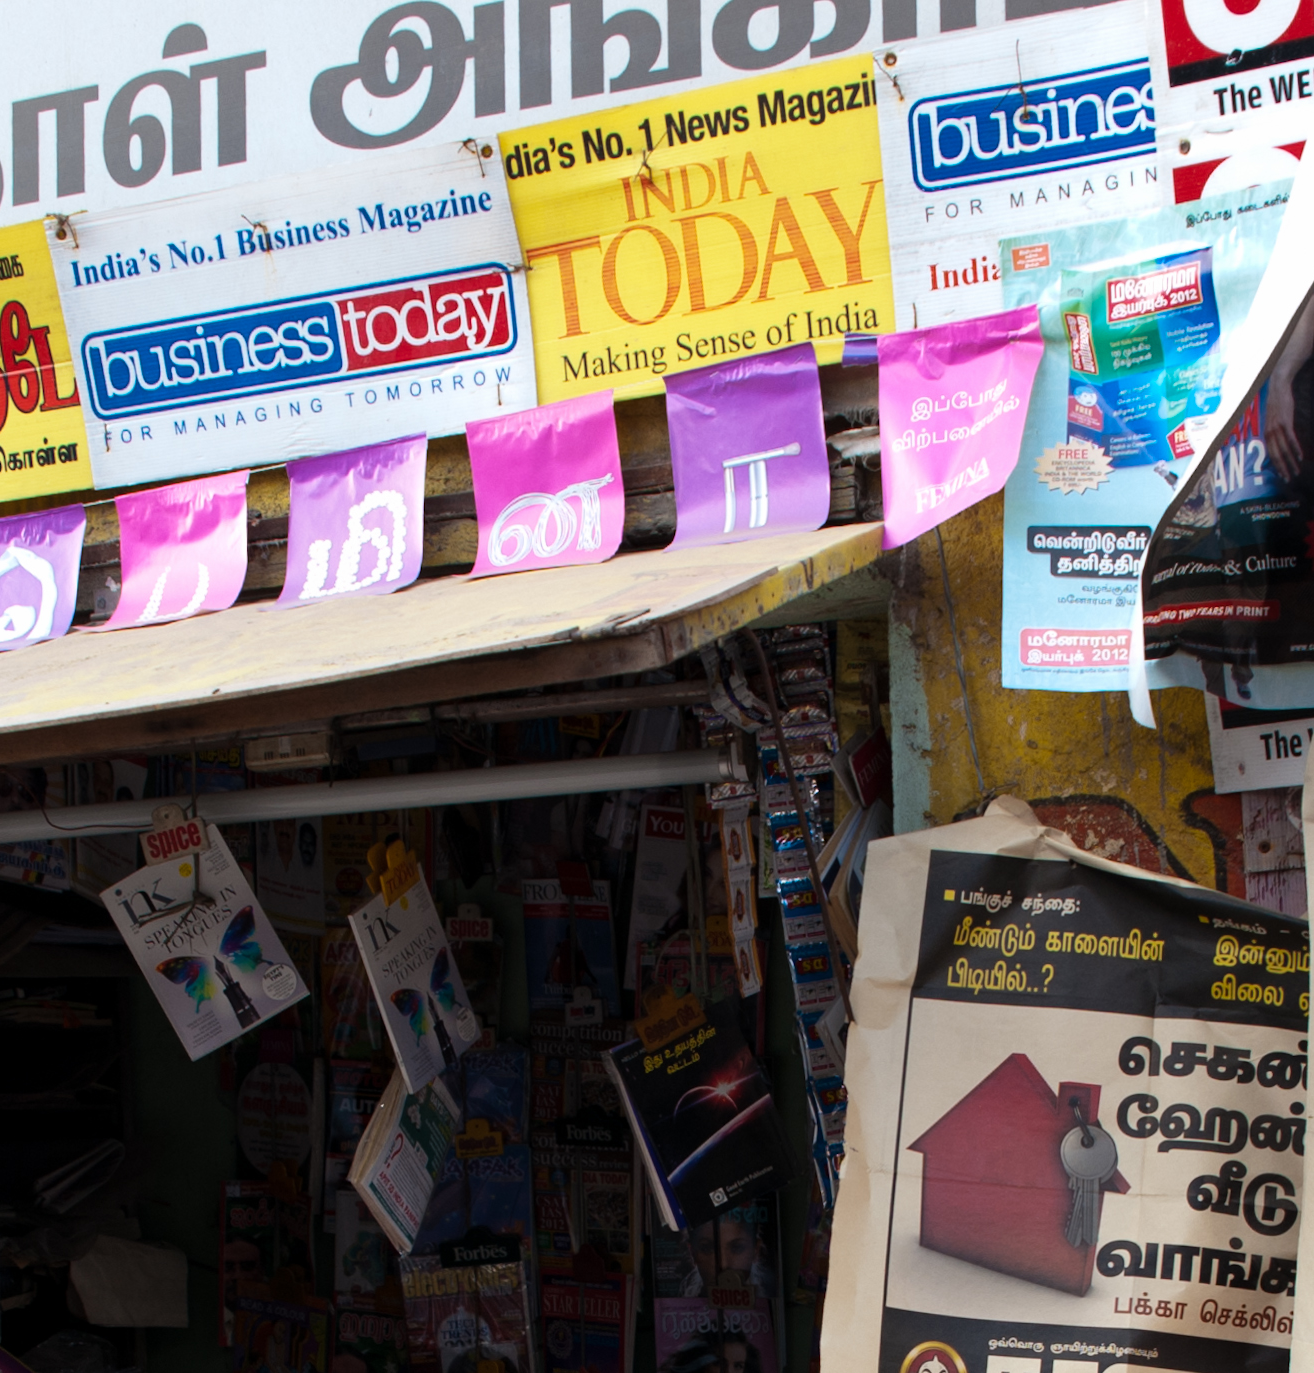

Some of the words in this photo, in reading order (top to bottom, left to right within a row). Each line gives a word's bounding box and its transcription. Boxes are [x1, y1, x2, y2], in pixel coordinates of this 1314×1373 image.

[1213, 83, 1263, 117] The
[665, 103, 750, 147] News
[619, 150, 774, 224] INDIA
[237, 211, 350, 256] Business
[357, 188, 494, 240] Magazine
[924, 197, 984, 223] FOR
[525, 179, 885, 340] TODAY
[1170, 287, 1200, 306] 2012
[92, 308, 336, 399] business
[343, 277, 506, 354] today
[562, 340, 669, 385] Making
[675, 329, 758, 364] Sense
[803, 302, 881, 338] India
[174, 397, 325, 436] MANAGING
[345, 366, 514, 407] TOMORROW
[910, 378, 1009, 424] இப்போது
[915, 457, 991, 517] FEMINA
[1244, 553, 1298, 576] Culture
[1026, 633, 1129, 650] மனோரமா
[1094, 649, 1129, 664] 2012
[146, 820, 202, 860] spice
[449, 918, 490, 938] spice
[953, 916, 1037, 957] மீண்டும்
[1045, 923, 1166, 963] காளையின்
[1210, 973, 1284, 1006] விலை
[664, 1024, 718, 1061] உதயத்தின்
[565, 1125, 613, 1144] Forbes
[1186, 1160, 1299, 1236] வீடு
[453, 1243, 508, 1263] Forbes
[1113, 1293, 1189, 1322] பக்கா
